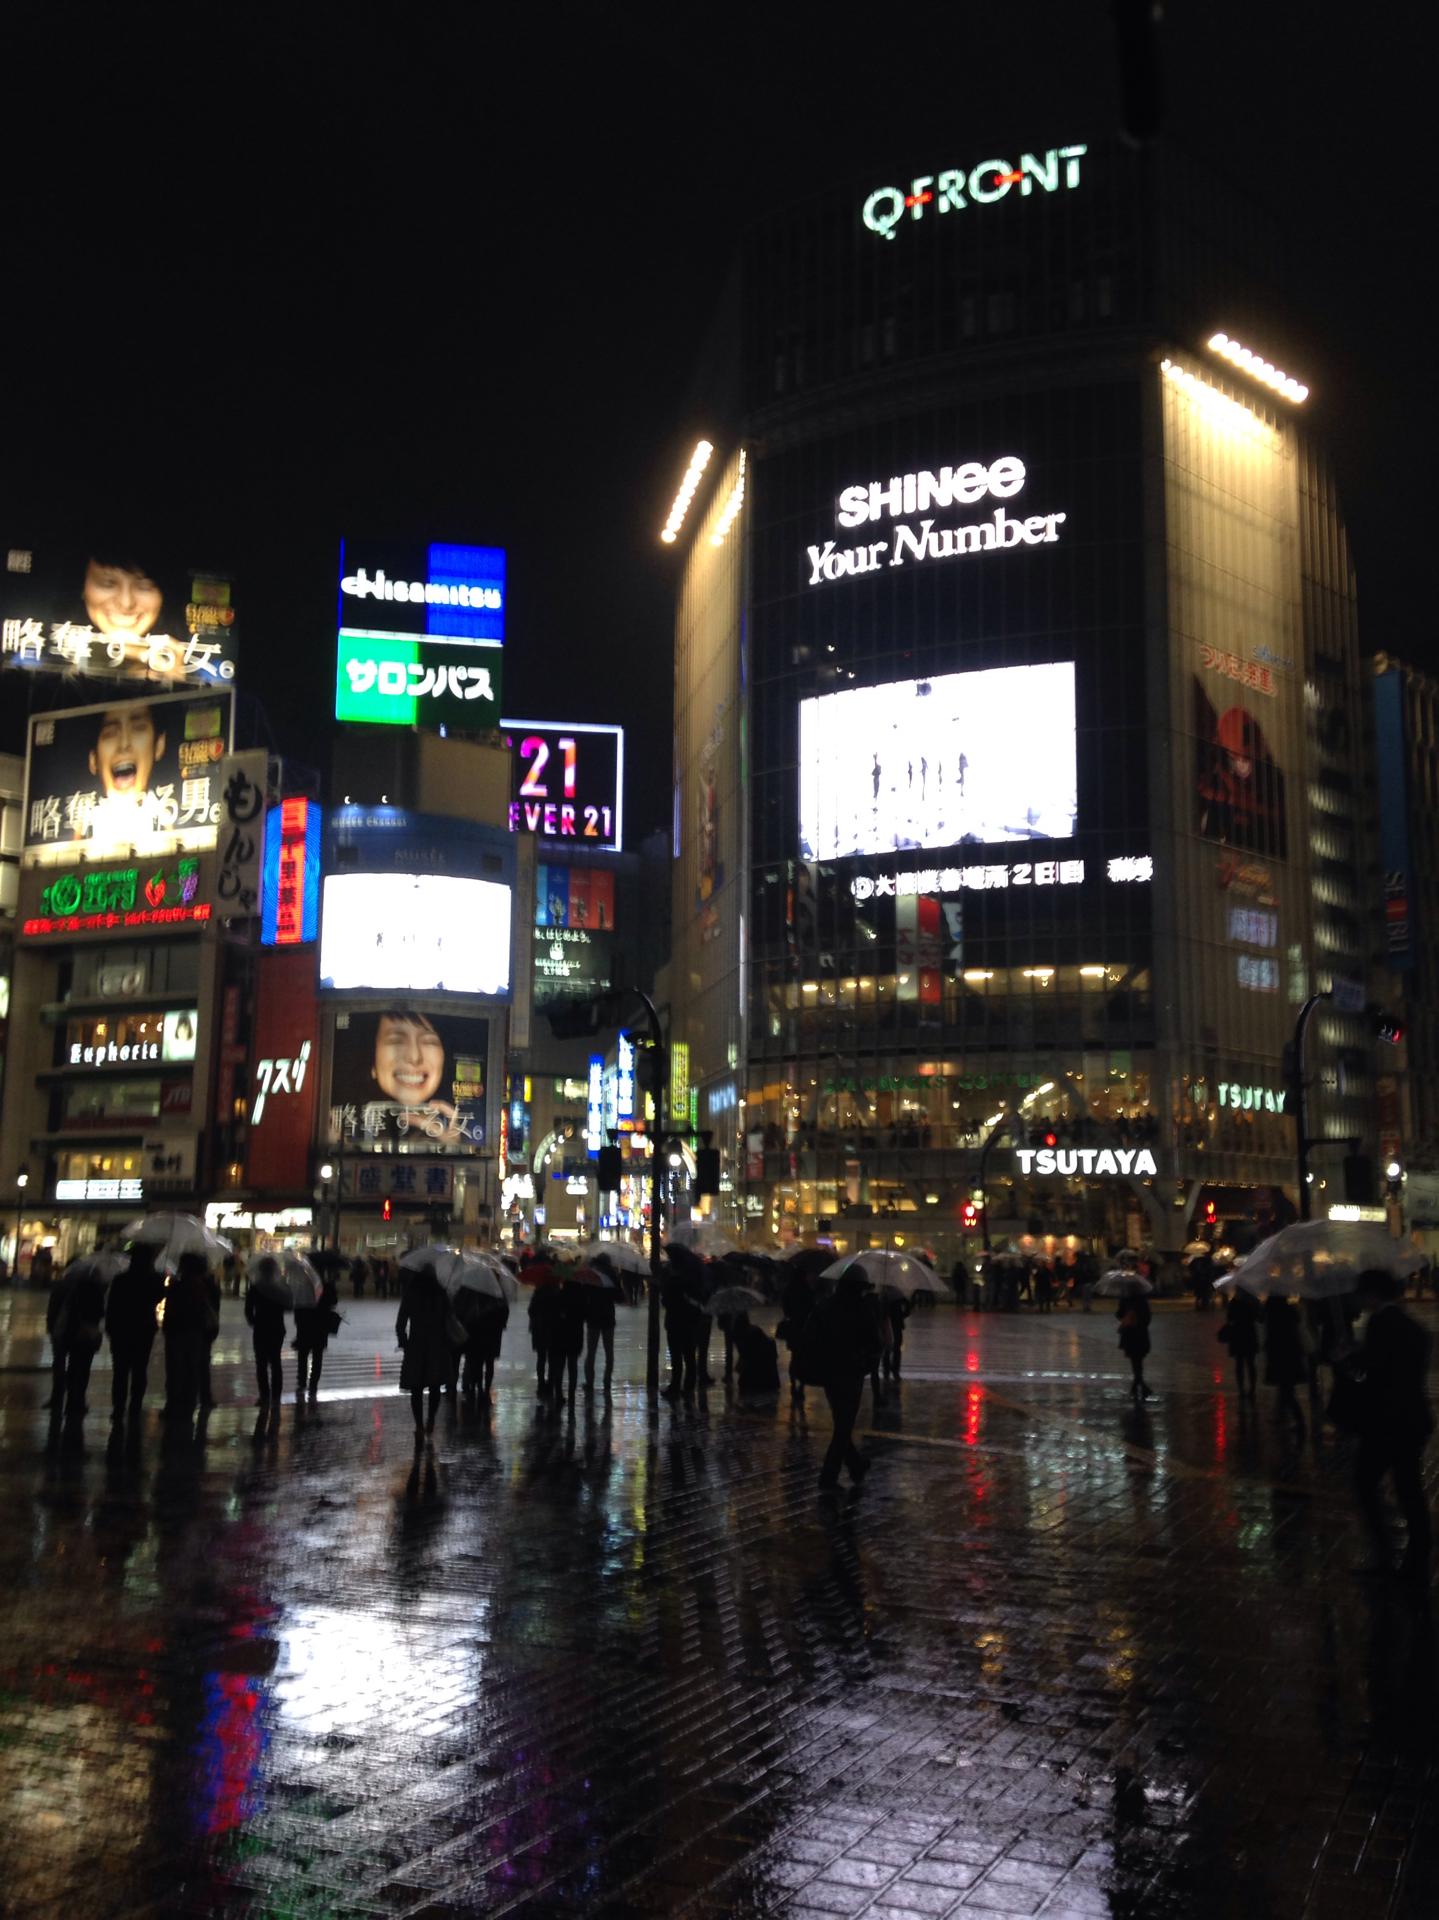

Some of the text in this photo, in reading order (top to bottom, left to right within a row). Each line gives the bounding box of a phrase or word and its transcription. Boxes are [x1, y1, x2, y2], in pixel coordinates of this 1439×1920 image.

[862, 144, 1087, 239] QFRONT
[838, 456, 1027, 528] SHINee
[807, 508, 1067, 586] Your Number
[346, 657, 495, 701] サロンパス
[584, 805, 613, 838] 21
[1016, 1149, 1158, 1175] TSUTAYA
